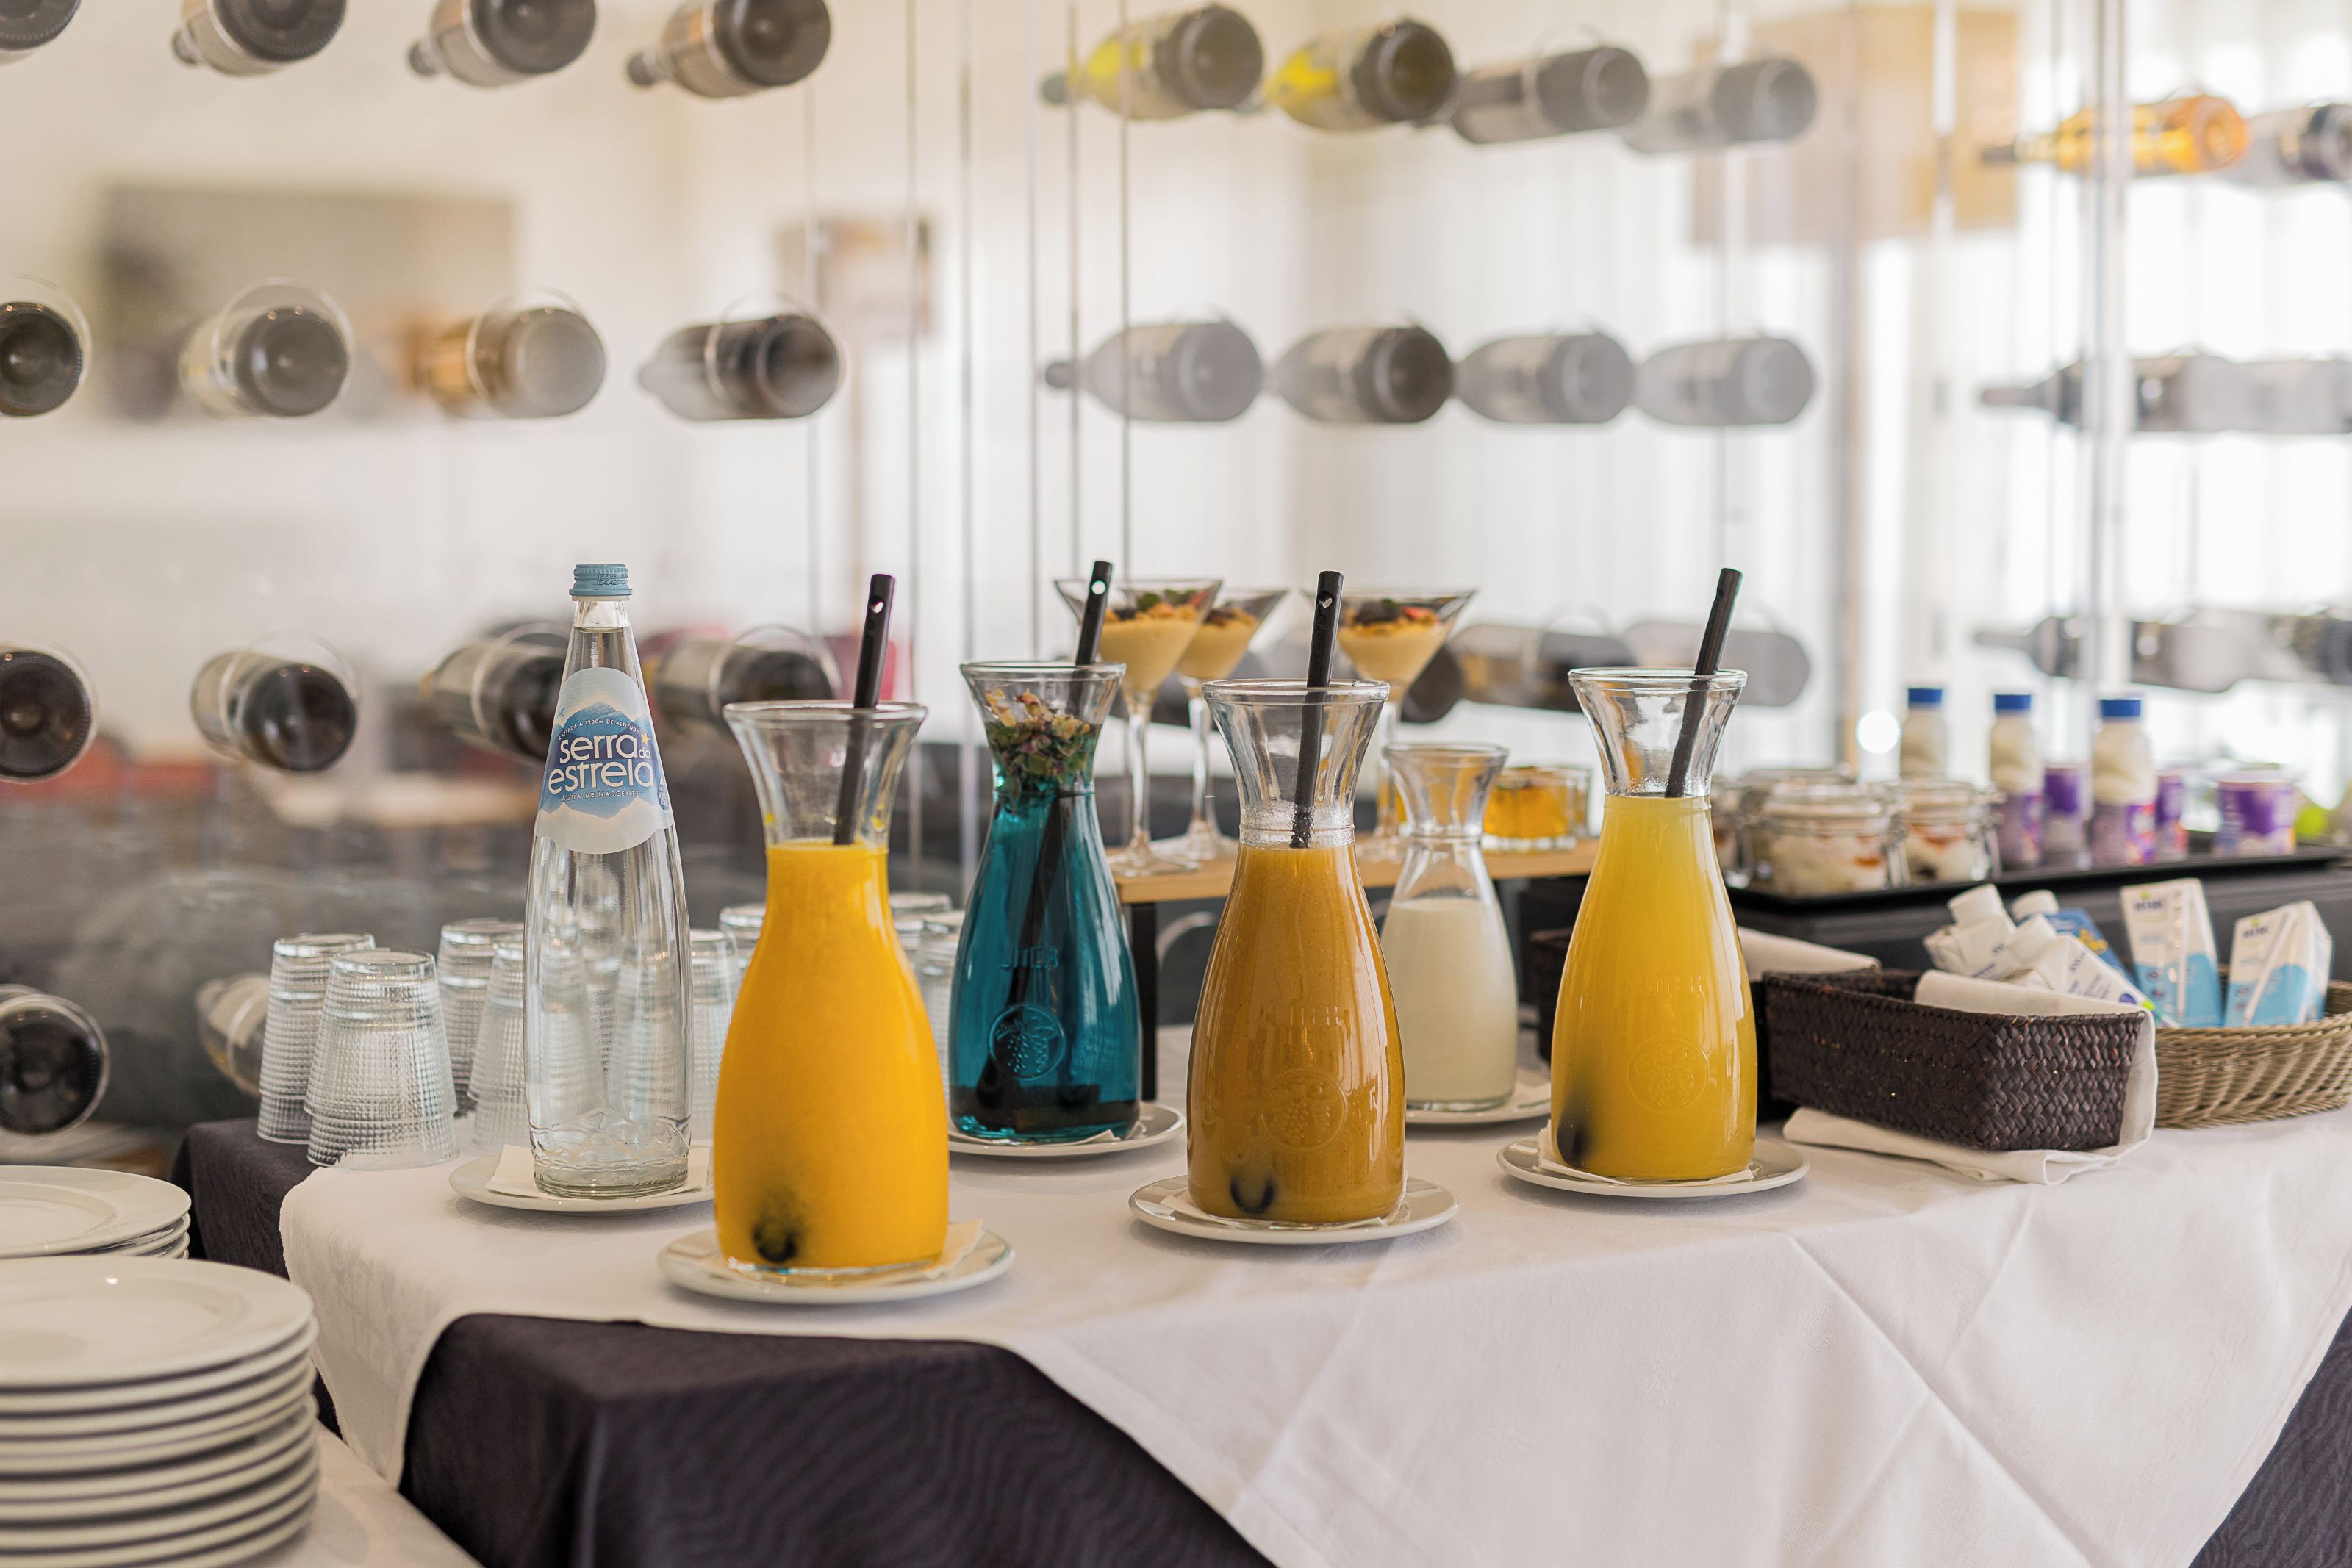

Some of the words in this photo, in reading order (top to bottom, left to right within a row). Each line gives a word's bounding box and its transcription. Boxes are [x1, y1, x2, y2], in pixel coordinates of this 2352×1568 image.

[558, 724, 578, 741] CAPTADA
[615, 721, 640, 735] ALTITUDE
[559, 734, 638, 764] serra
[638, 747, 651, 759] da
[548, 759, 654, 794] estrela
[598, 790, 640, 798] NASCENTE
